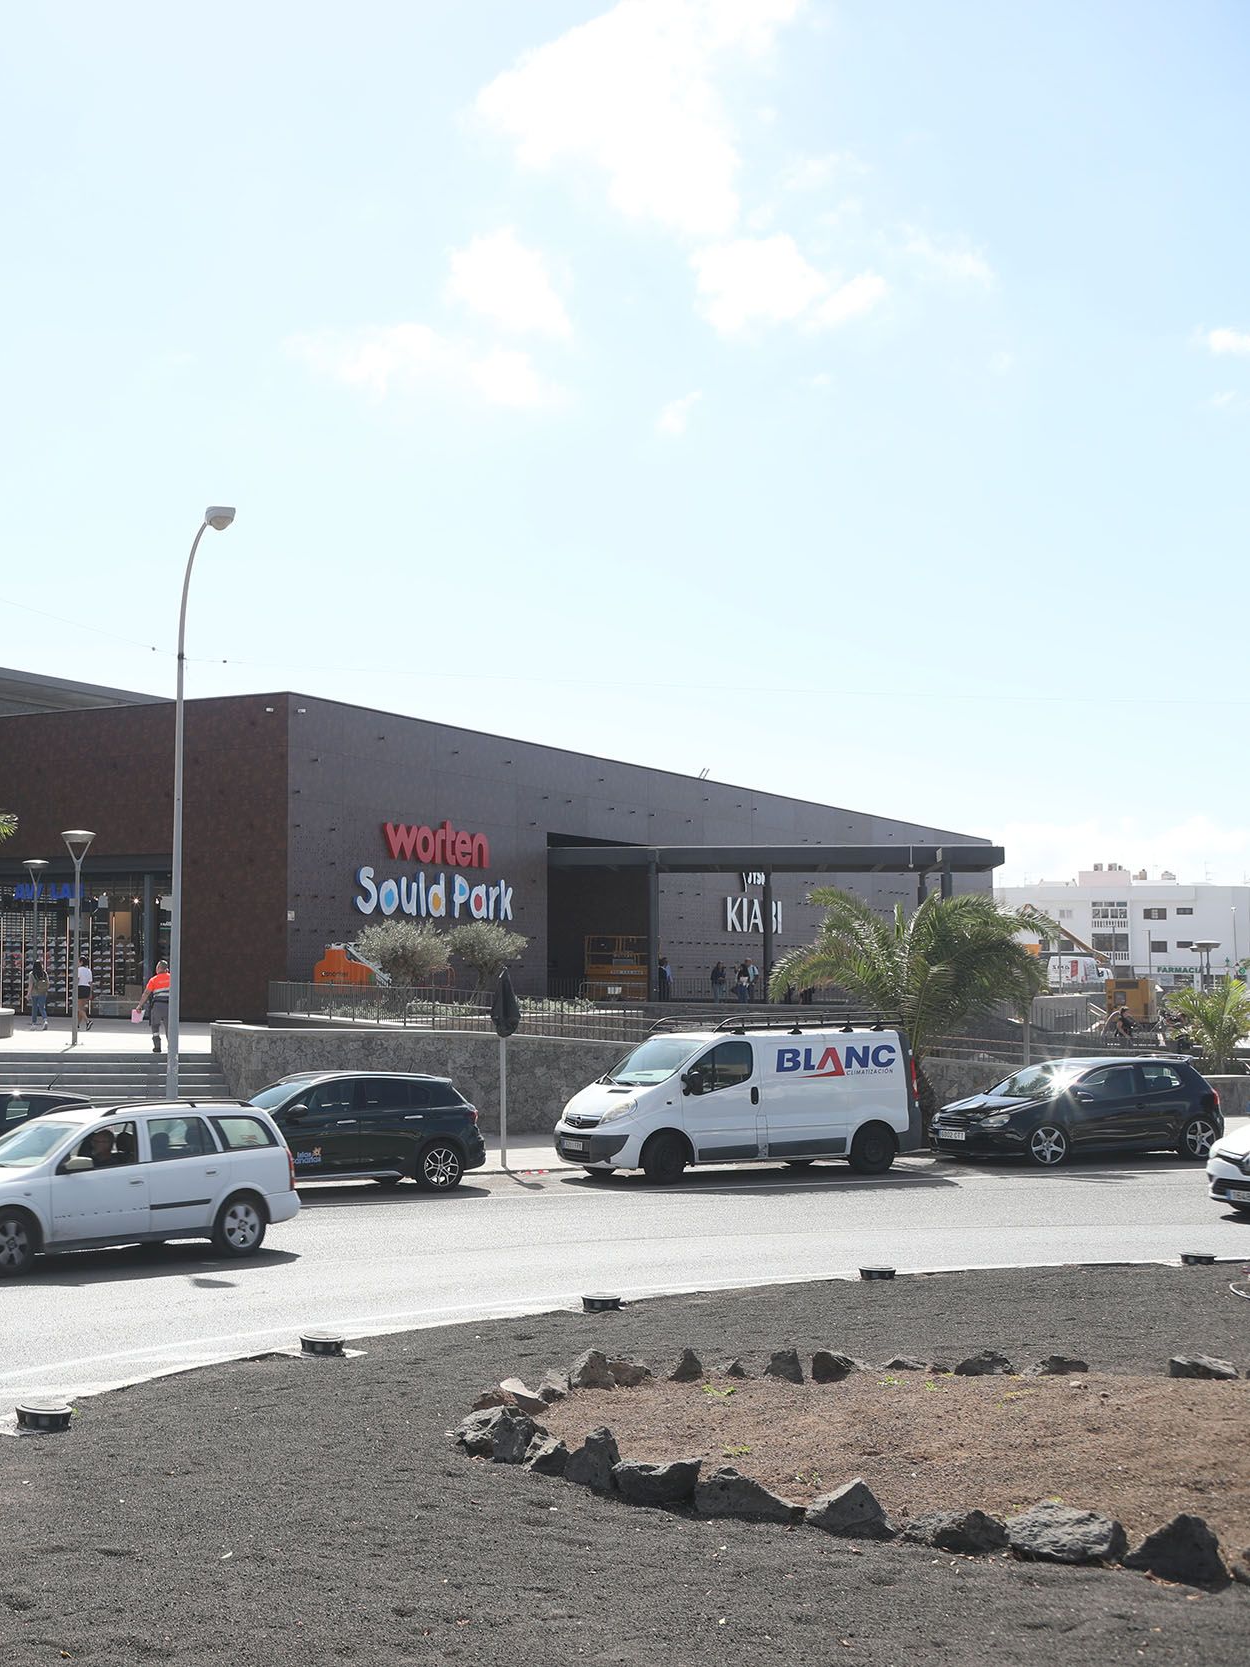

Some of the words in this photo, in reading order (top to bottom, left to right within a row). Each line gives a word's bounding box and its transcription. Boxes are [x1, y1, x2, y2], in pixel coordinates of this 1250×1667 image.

[383, 819, 491, 868] worten
[354, 866, 447, 918] Sould
[452, 873, 514, 921] Park
[776, 1044, 897, 1075] BLANC
[846, 1068, 894, 1077] CLIMATIZACIÓN
